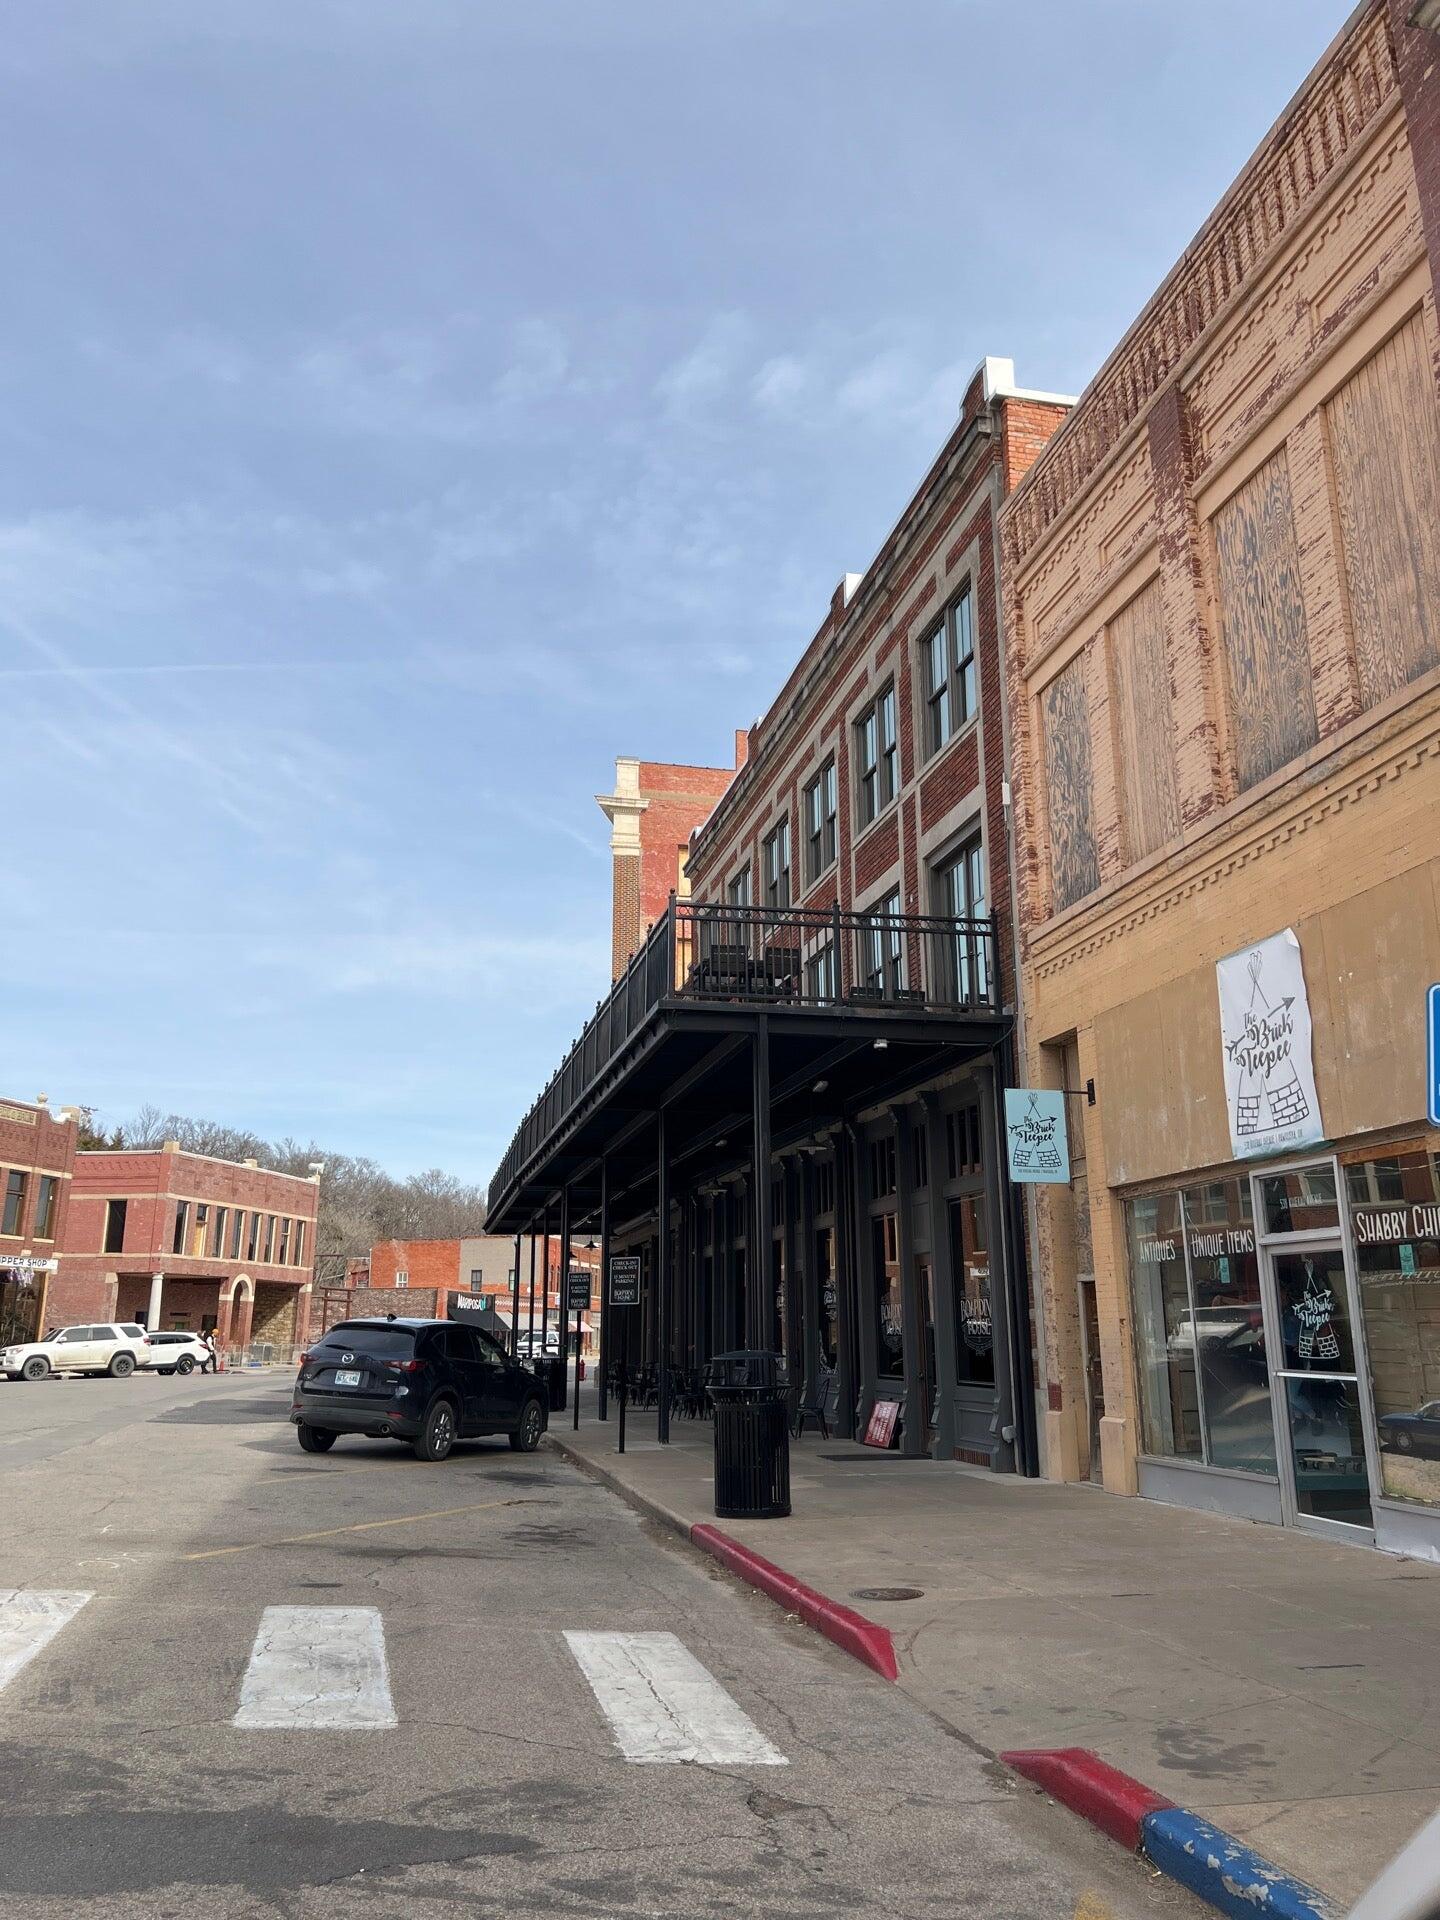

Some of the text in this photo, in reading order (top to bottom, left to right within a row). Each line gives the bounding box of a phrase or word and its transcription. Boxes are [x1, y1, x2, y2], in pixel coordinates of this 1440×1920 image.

[1246, 1013, 1294, 1050] Brick
[1234, 1040, 1291, 1079] Teepee
[1015, 1130, 1054, 1146] Teepee
[1025, 1121, 1055, 1135] Brick
[1356, 1211, 1407, 1242] SHABBY
[1139, 1238, 1176, 1263] ANTIQUES
[1191, 1229, 1255, 1258] UNIQUE ITEMS
[0, 1256, 47, 1267] PPER SHOP
[457, 1293, 483, 1310] MARIPOSA
[1305, 1297, 1332, 1315] Brick
[1297, 1310, 1329, 1331] Teepee
